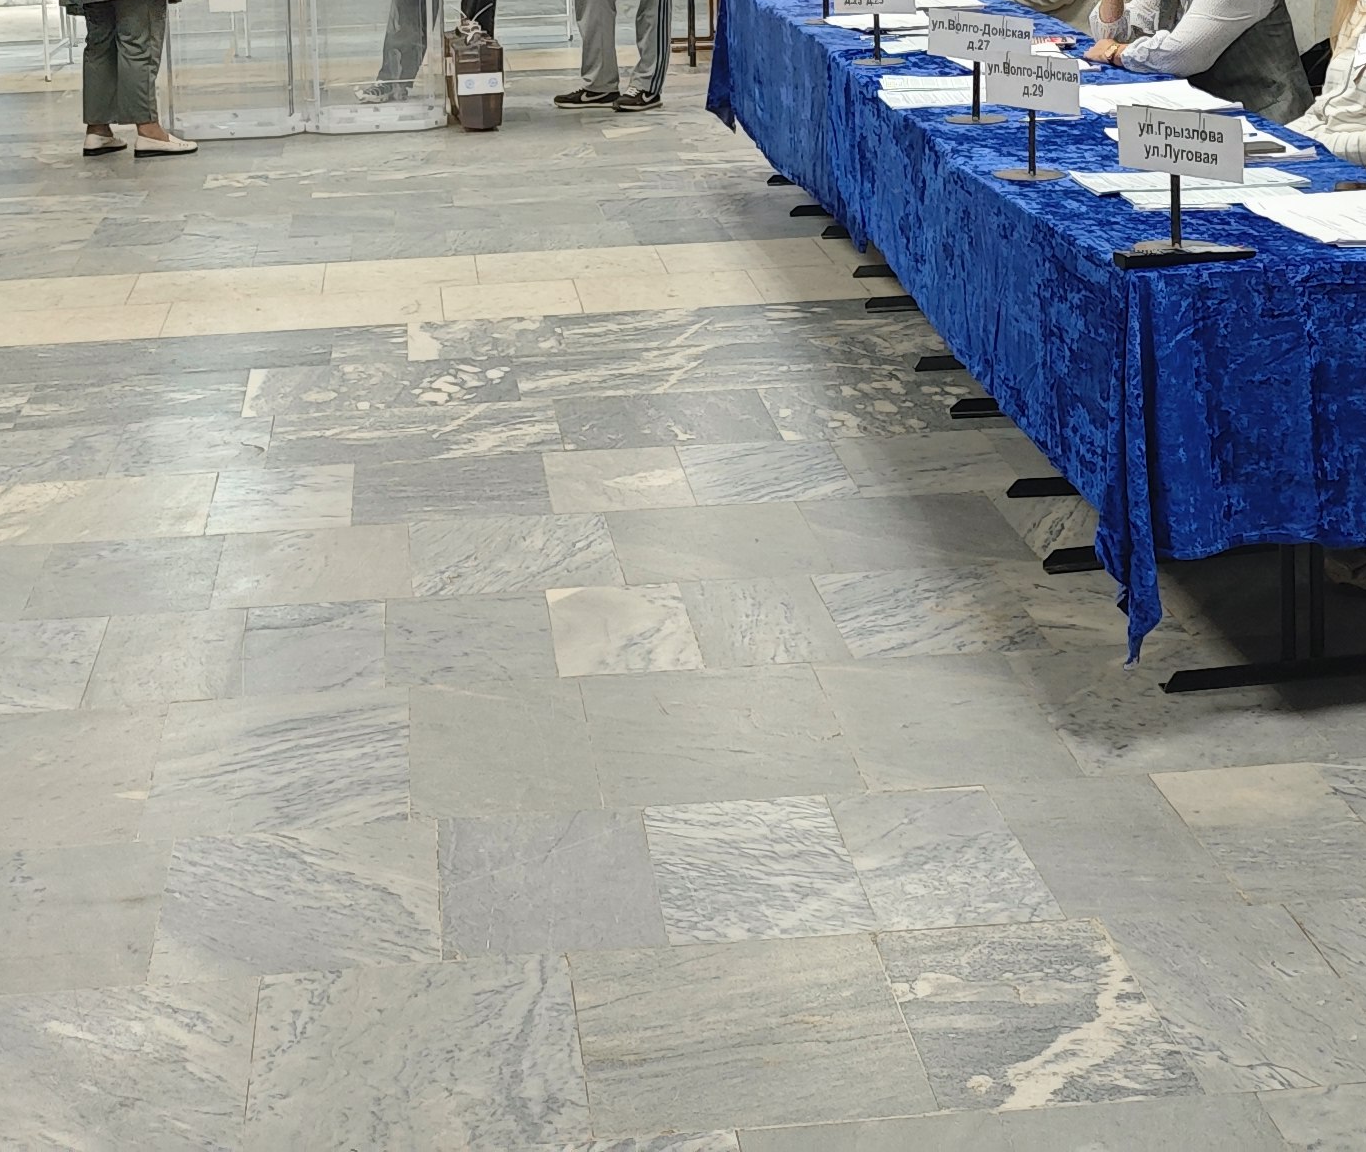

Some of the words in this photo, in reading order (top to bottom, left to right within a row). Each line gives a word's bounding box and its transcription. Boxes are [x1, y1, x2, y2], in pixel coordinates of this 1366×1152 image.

[931, 18, 1031, 40] ул.Волго-Донская
[967, 39, 990, 52] д.27
[987, 62, 1079, 84] ул.Волго-Донская
[1022, 83, 1044, 98] д.29
[1138, 120, 1224, 144] ул.Грызлова
[1143, 143, 1218, 165] ул.Луговая
